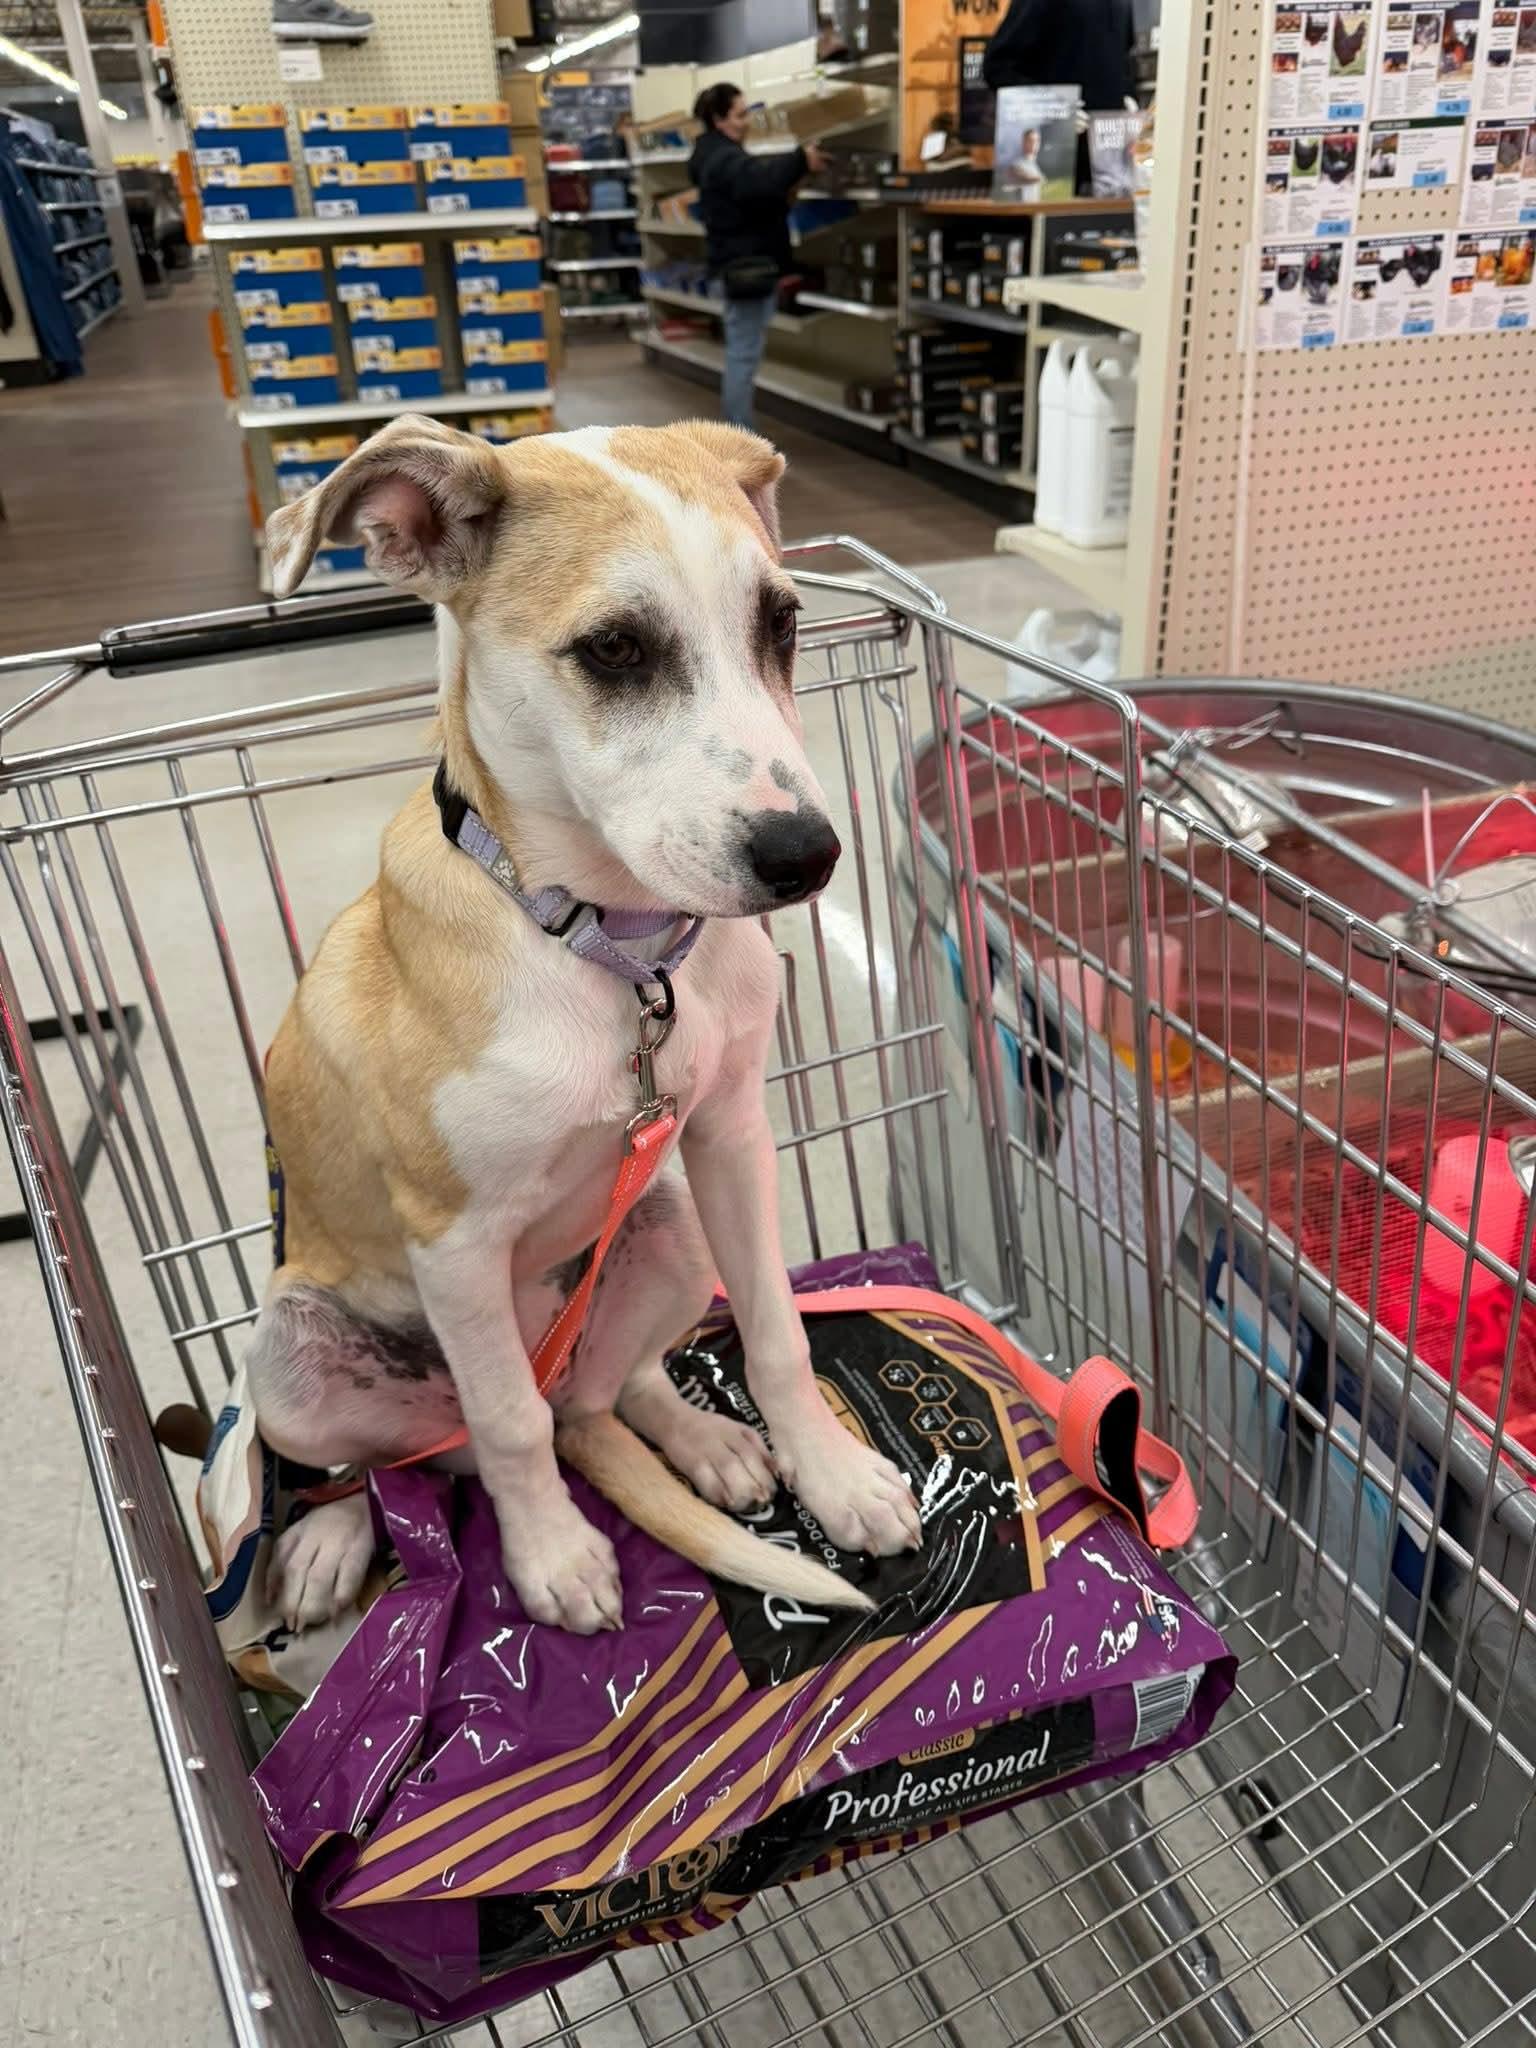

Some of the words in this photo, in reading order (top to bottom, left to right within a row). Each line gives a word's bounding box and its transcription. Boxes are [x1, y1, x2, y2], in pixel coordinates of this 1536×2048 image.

[908, 1733, 965, 1761] Classic
[824, 1729, 1050, 1832] Professional
[916, 1808, 932, 1818] OF
[602, 1902, 668, 1931] PREMIUM
